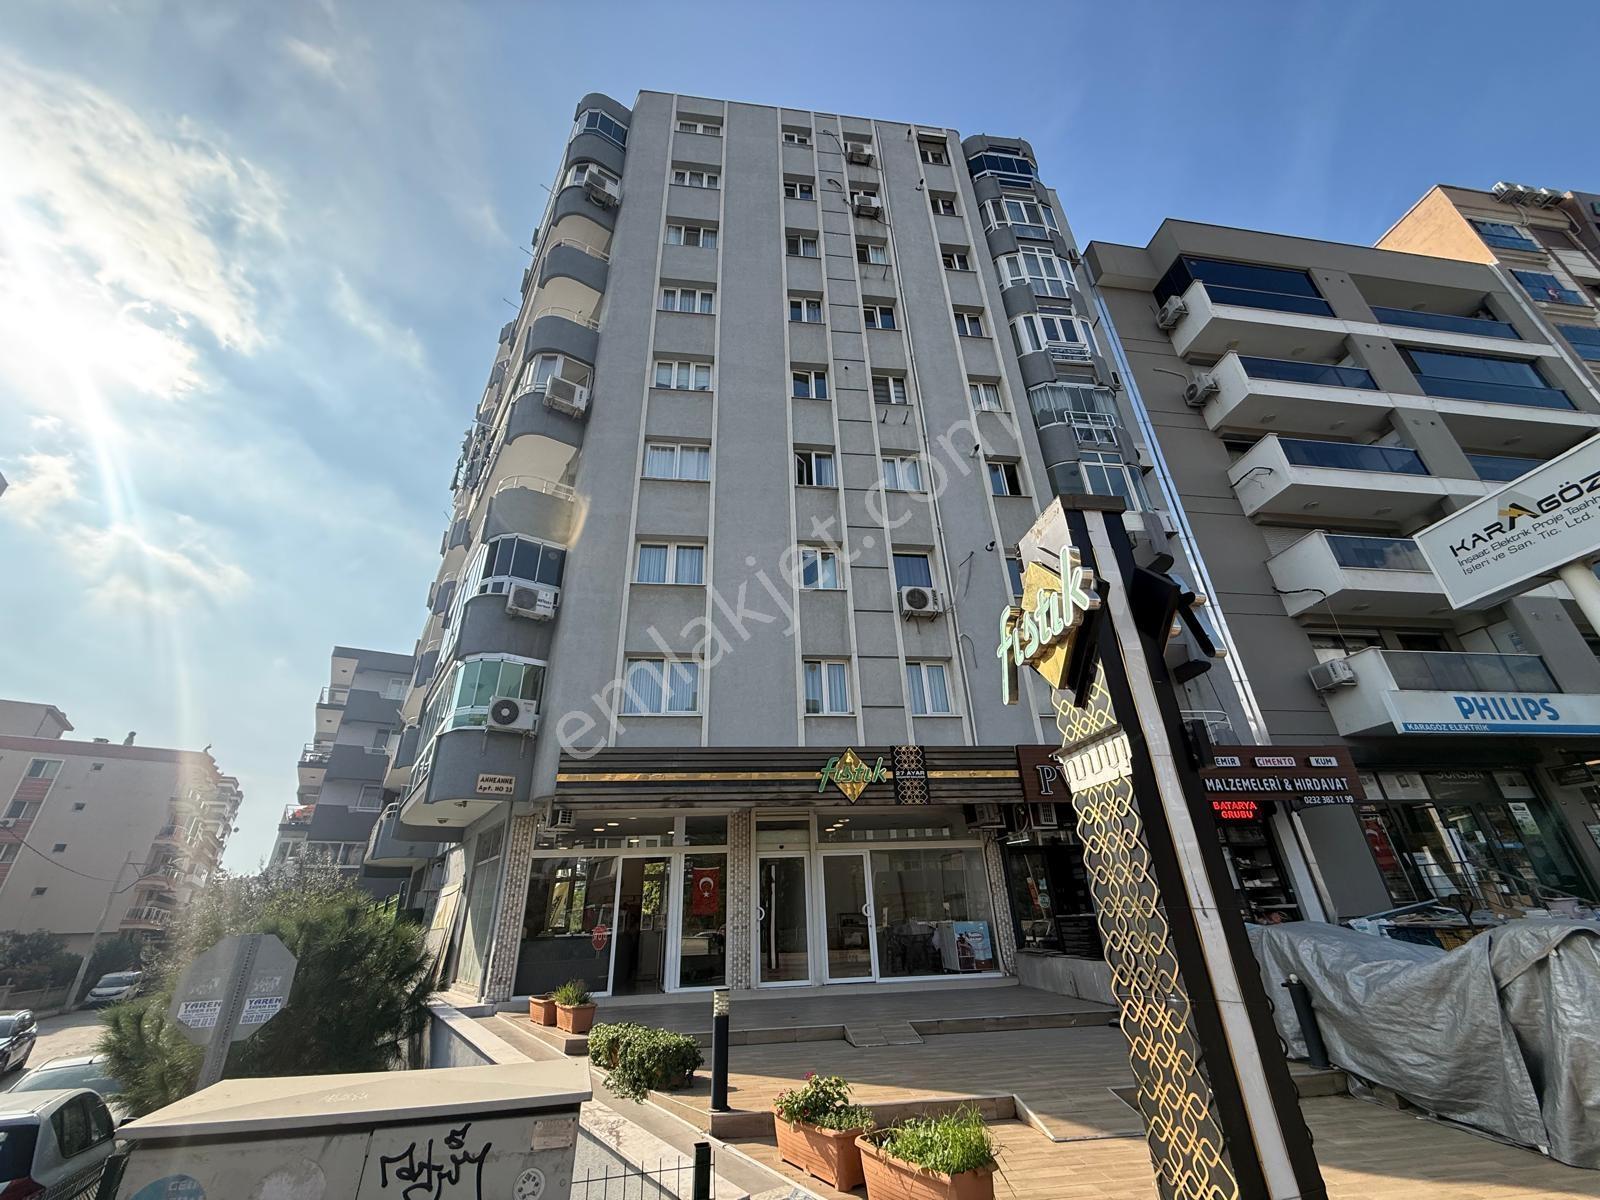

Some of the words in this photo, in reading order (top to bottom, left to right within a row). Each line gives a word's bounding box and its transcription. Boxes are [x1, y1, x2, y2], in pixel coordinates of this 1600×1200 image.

[1449, 471, 1600, 557] KARAGÖZ
[1491, 529, 1531, 551] Elektrik
[1532, 513, 1564, 532] Proje
[1492, 551, 1505, 561] ve
[1507, 540, 1536, 555] San.
[1537, 529, 1562, 541] Tic.
[1564, 511, 1595, 528] Ltd.
[1453, 696, 1560, 721] PHILIPS
[1406, 723, 1449, 731] KARAGÖZ
[1215, 757, 1237, 766] EMİR
[1314, 758, 1333, 766] KUM
[1205, 775, 1282, 791] MALZEMELERİ
[1284, 777, 1293, 791] &
[1295, 777, 1349, 791] HIRDAVAT
[1303, 795, 1321, 804] 0232
[1335, 795, 1344, 803] 11
[1344, 795, 1354, 803] 99
[1212, 800, 1258, 810] BATARYA
[1221, 810, 1253, 819] GRUBU
[184, 1001, 222, 1009] YAREN
[249, 997, 282, 1005] YAREN
